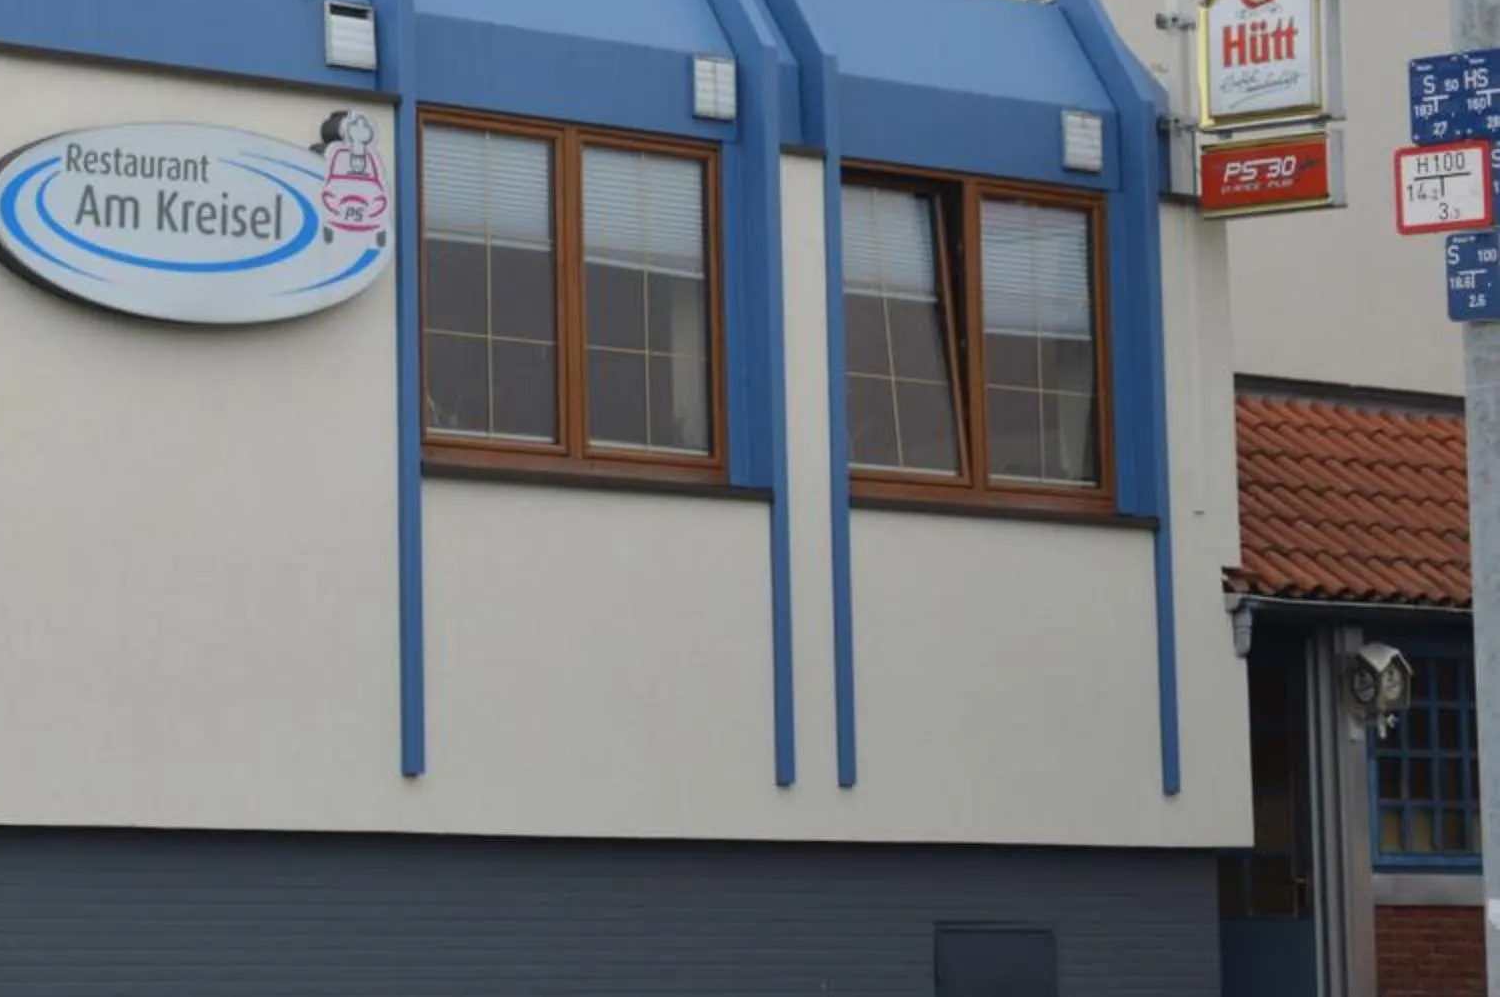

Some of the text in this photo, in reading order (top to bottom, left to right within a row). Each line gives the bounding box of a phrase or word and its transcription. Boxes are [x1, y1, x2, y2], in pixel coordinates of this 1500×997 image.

[1222, 16, 1298, 68] Hütt
[1423, 74, 1437, 94] S
[66, 142, 210, 184] Restaurant
[1223, 160, 1259, 183] PS
[75, 184, 283, 241] Am Kreisel
[344, 206, 364, 222] PS
[1447, 244, 1460, 265] S
